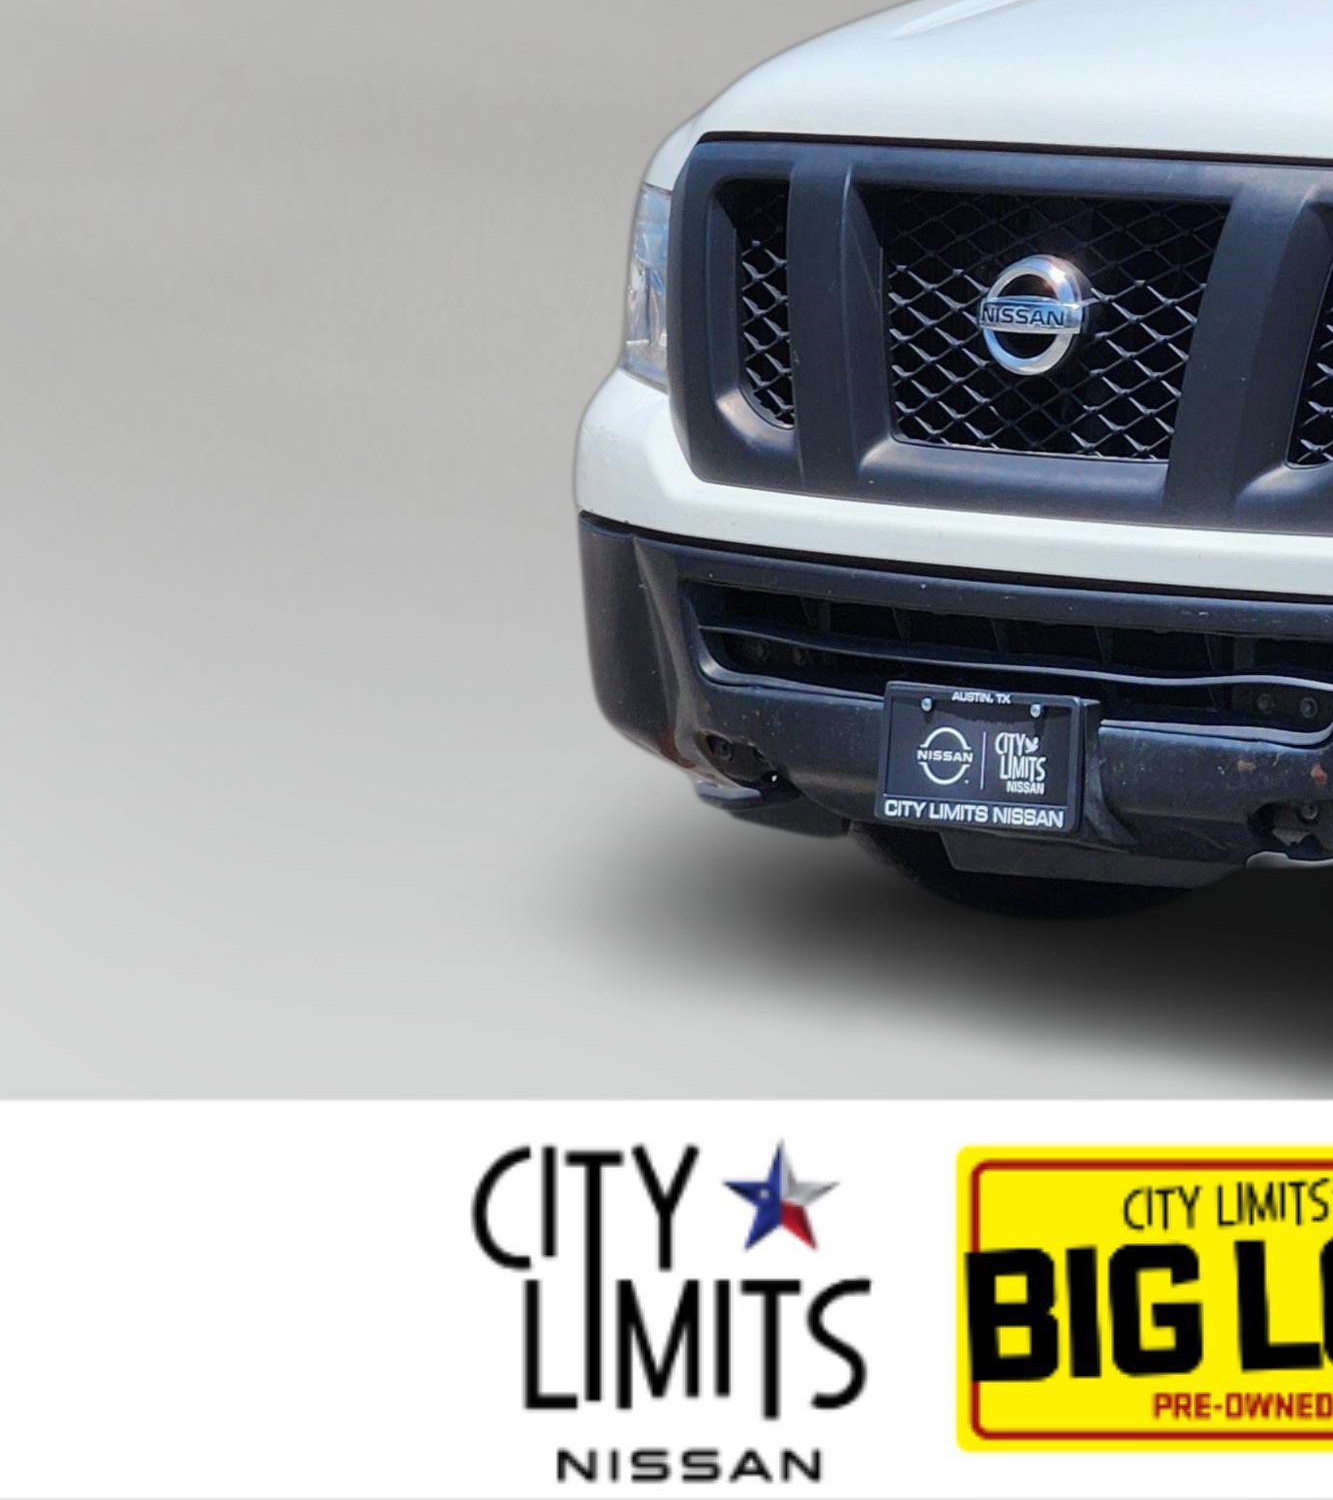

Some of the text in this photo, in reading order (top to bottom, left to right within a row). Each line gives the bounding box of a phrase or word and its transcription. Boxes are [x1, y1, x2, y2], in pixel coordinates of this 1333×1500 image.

[981, 306, 1064, 326] NISSAN
[996, 693, 1012, 705] TX
[995, 732, 1026, 758] CITY
[916, 749, 974, 763] NISSAN
[1000, 755, 1046, 783] LIMITS
[1006, 781, 1045, 795] NISSAN
[884, 800, 1064, 829] CITY LIMITS NISSAN
